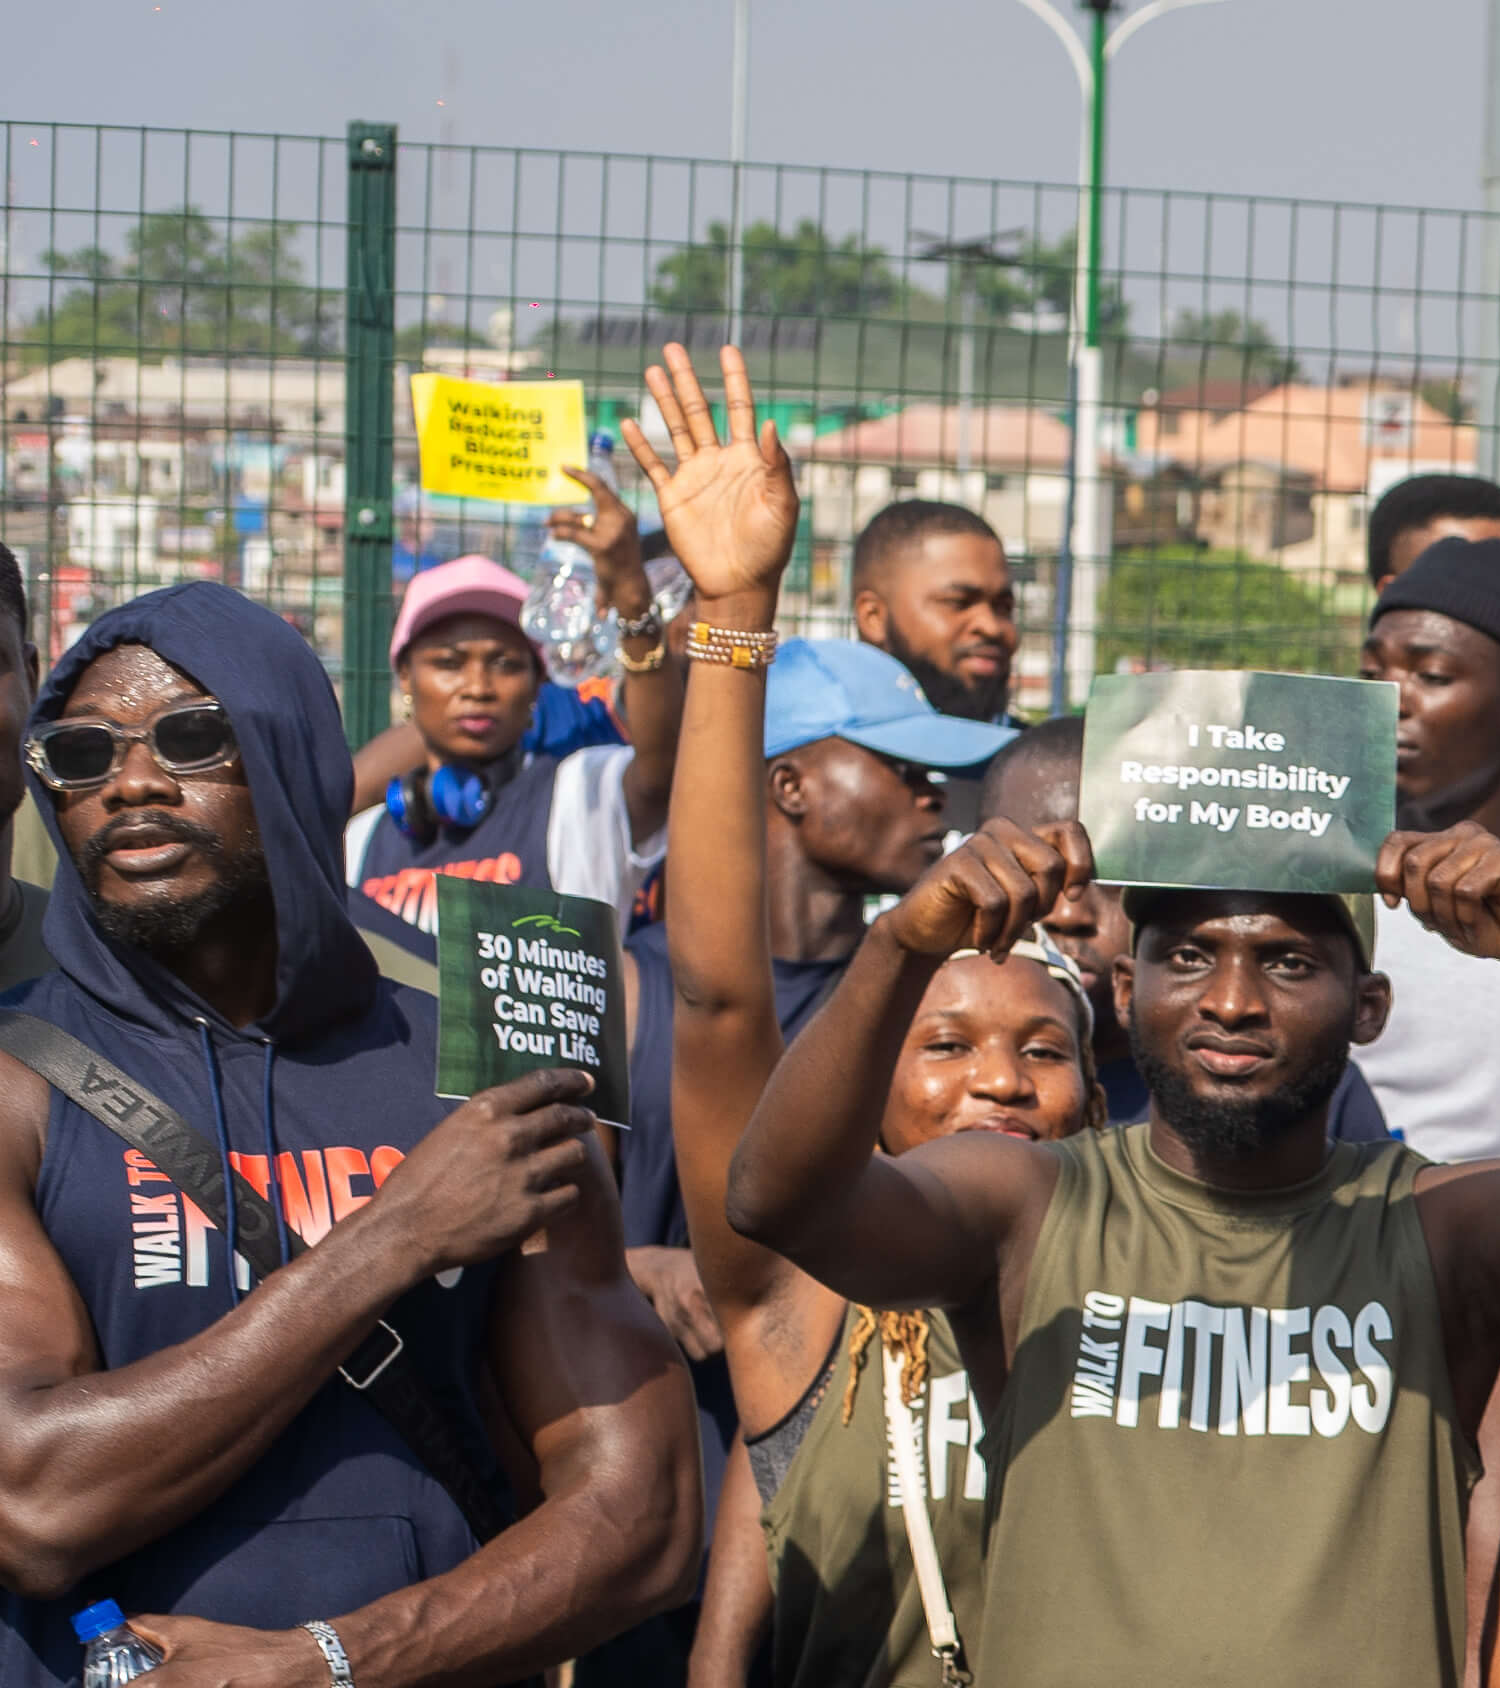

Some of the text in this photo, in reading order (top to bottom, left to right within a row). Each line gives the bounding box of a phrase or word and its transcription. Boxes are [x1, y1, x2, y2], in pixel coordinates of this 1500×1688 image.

[448, 398, 542, 424] Walking
[449, 418, 545, 440] Reduces
[450, 454, 548, 479] Pressure
[466, 439, 529, 459] Blood
[1187, 723, 1286, 752] I Take
[1120, 761, 1351, 800] Responsibility
[1134, 797, 1333, 837] for My Body
[477, 931, 607, 979] 30 Minutes
[481, 964, 606, 1014] of Walking
[494, 994, 600, 1037] Can Save
[493, 1023, 601, 1067] Your Life.
[133, 1192, 181, 1290] WALK
[1070, 1290, 1125, 1420] WALK TO
[1115, 1296, 1394, 1438] FITNESS
